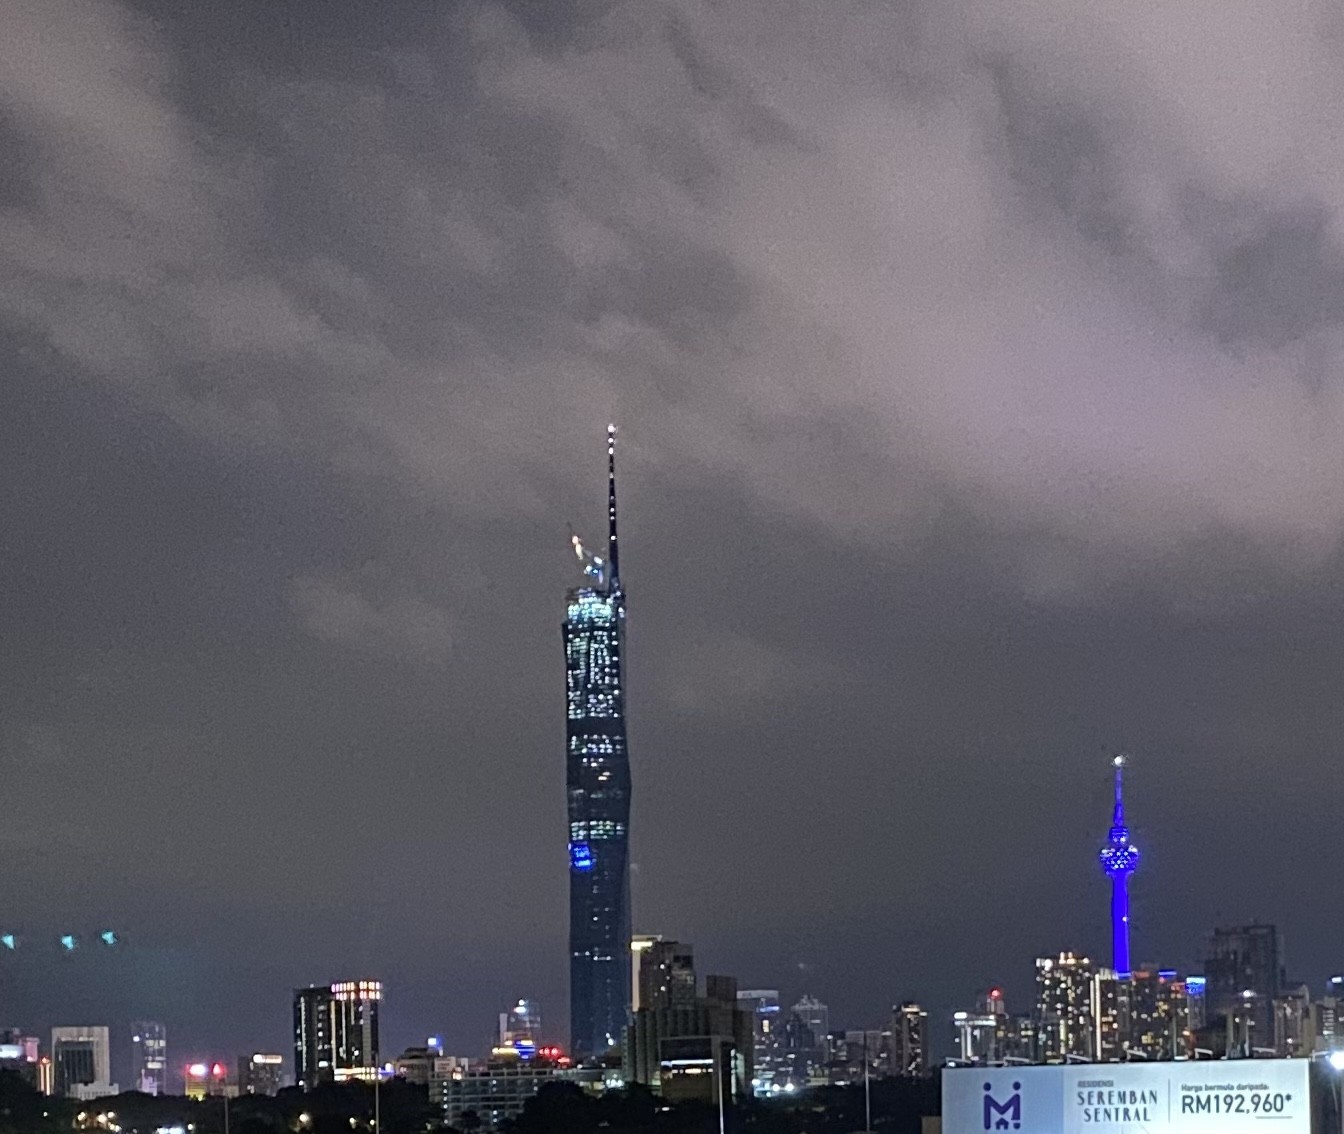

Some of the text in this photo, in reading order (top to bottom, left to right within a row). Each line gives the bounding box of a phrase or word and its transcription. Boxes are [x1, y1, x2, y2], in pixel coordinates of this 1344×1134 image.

[1181, 1084, 1203, 1092] Harga
[1205, 1083, 1234, 1091] bermula
[1077, 1090, 1158, 1106] SEREMBAN
[1084, 1107, 1151, 1122] SENTRAL
